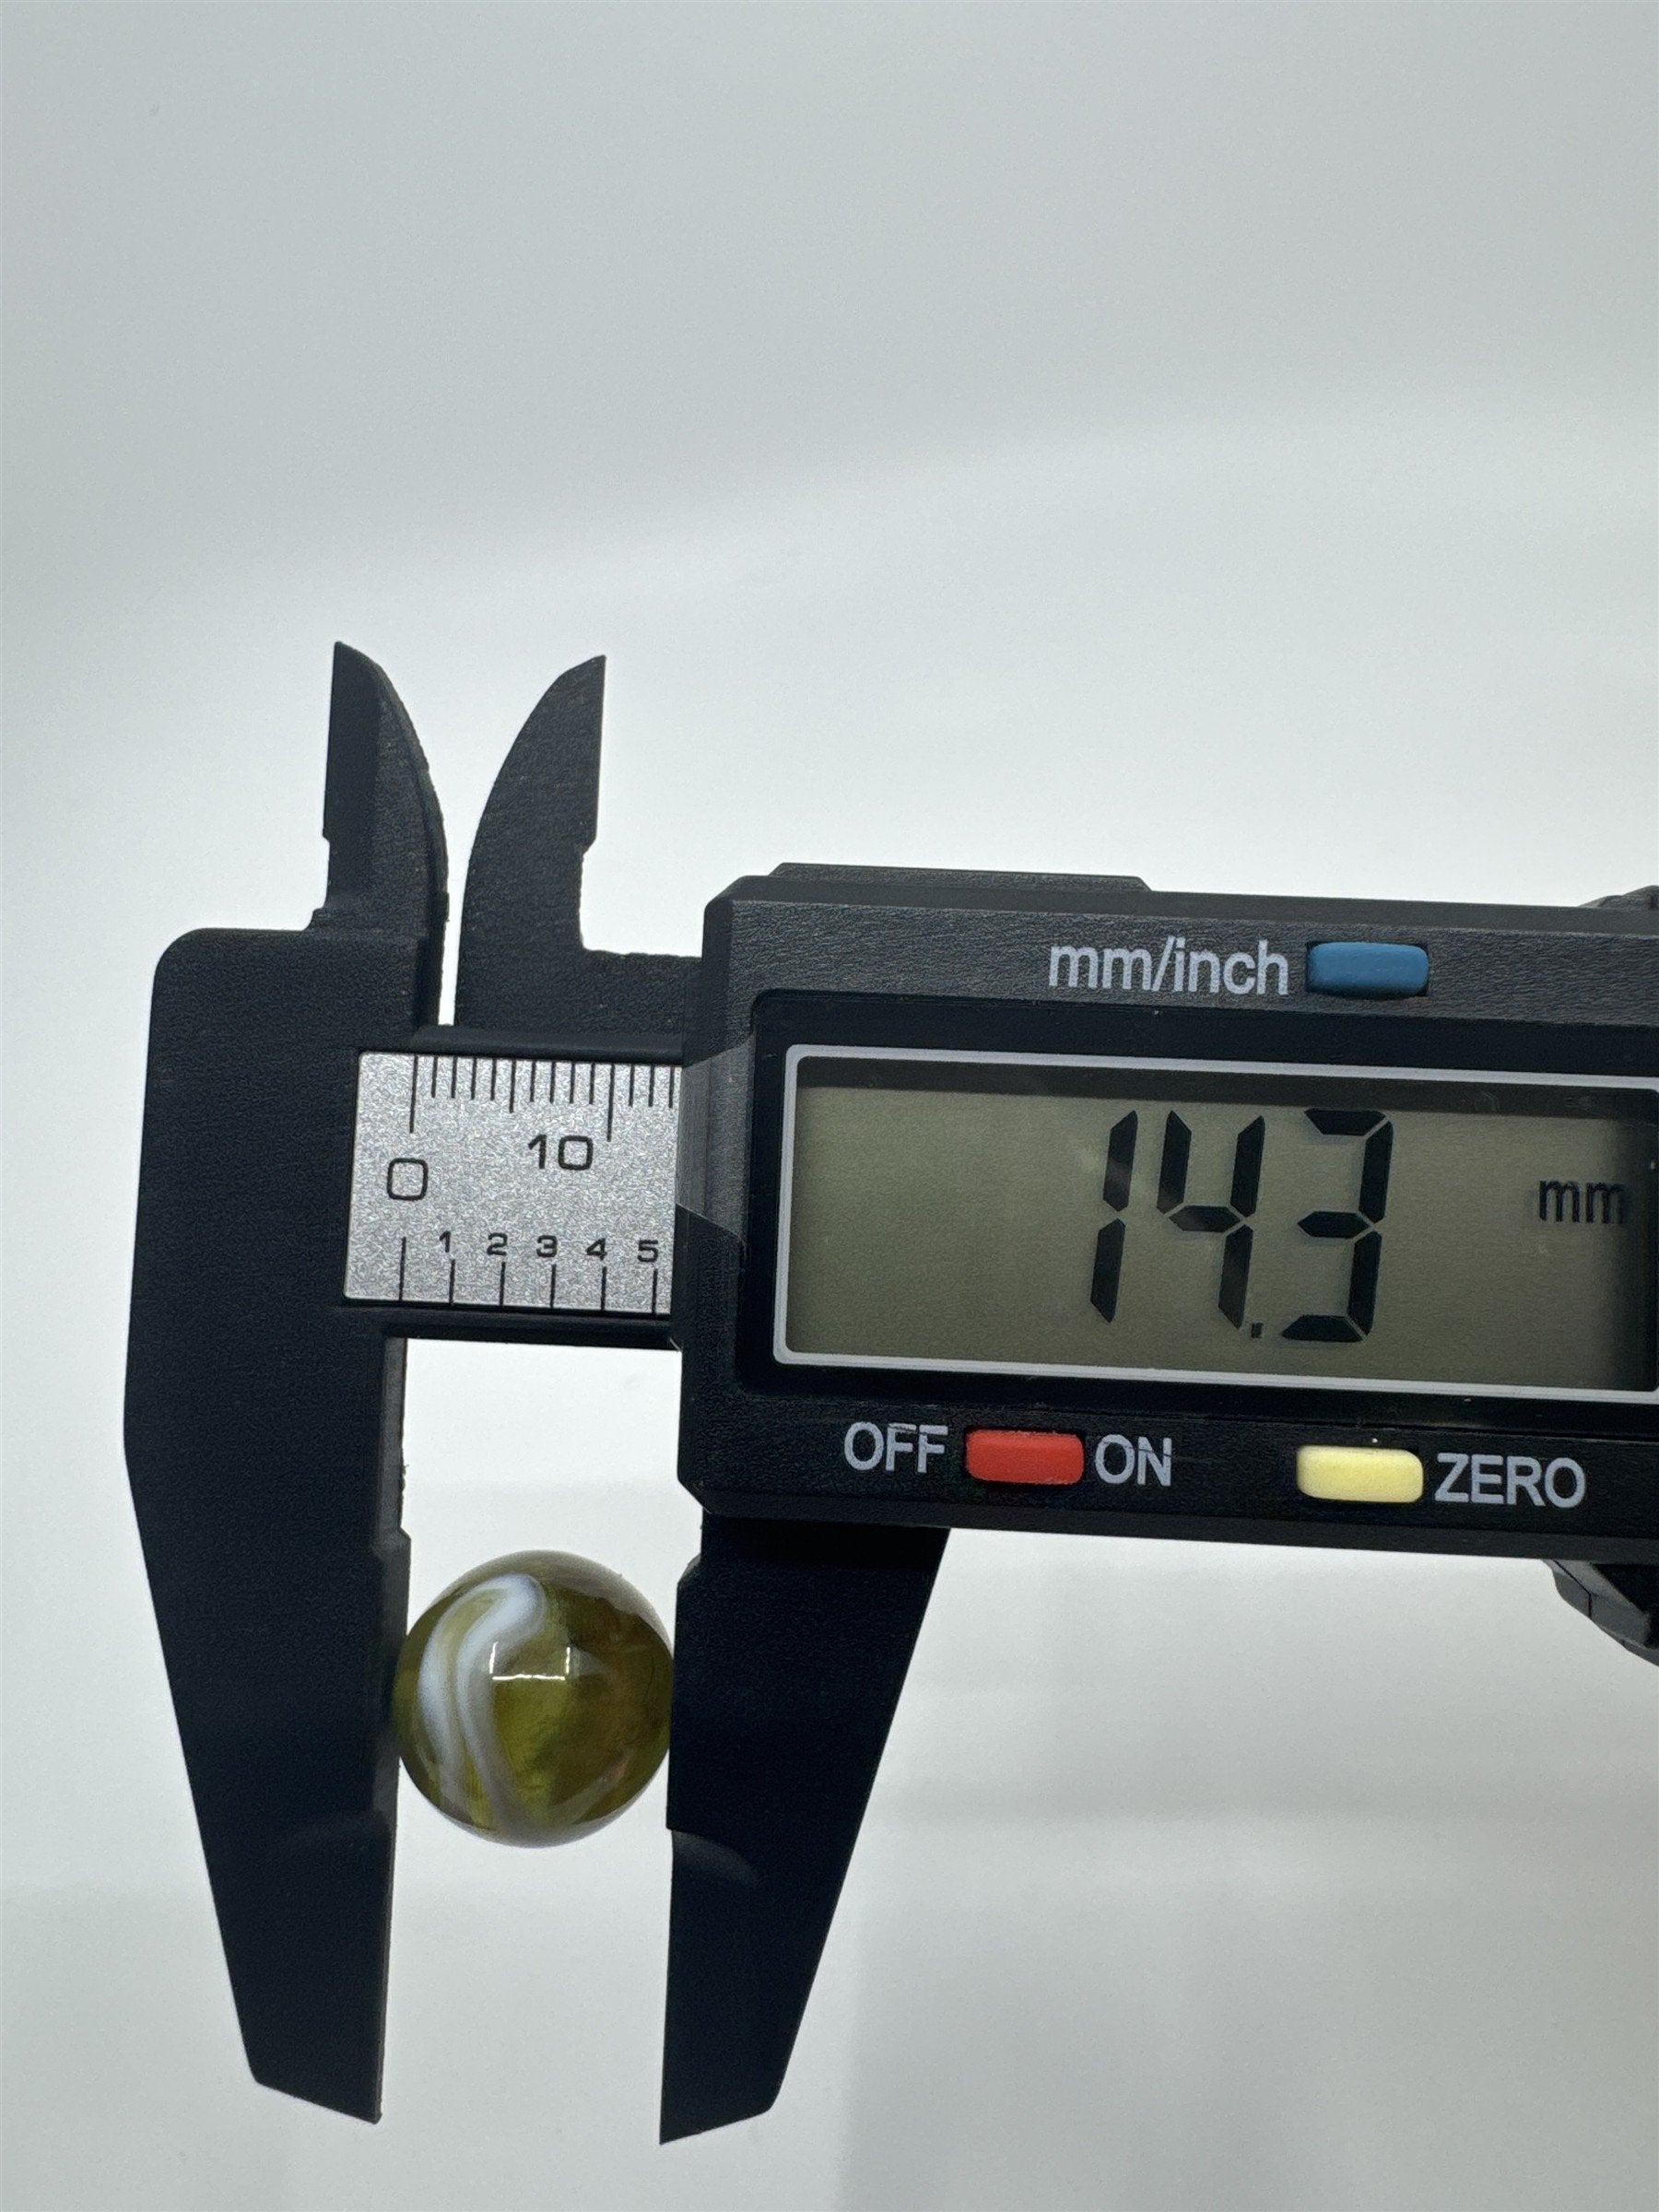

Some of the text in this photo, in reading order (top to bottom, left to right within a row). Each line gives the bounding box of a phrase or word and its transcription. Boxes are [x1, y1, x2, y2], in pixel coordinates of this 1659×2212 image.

[1049, 935, 1289, 995] mm/inch
[387, 1134, 594, 1200] 0 10
[439, 1230, 659, 1263] 1 2 3 4 5
[1090, 1108, 1626, 1343] 14.3 mm
[844, 1422, 1586, 1508] OFF ON ZERO
